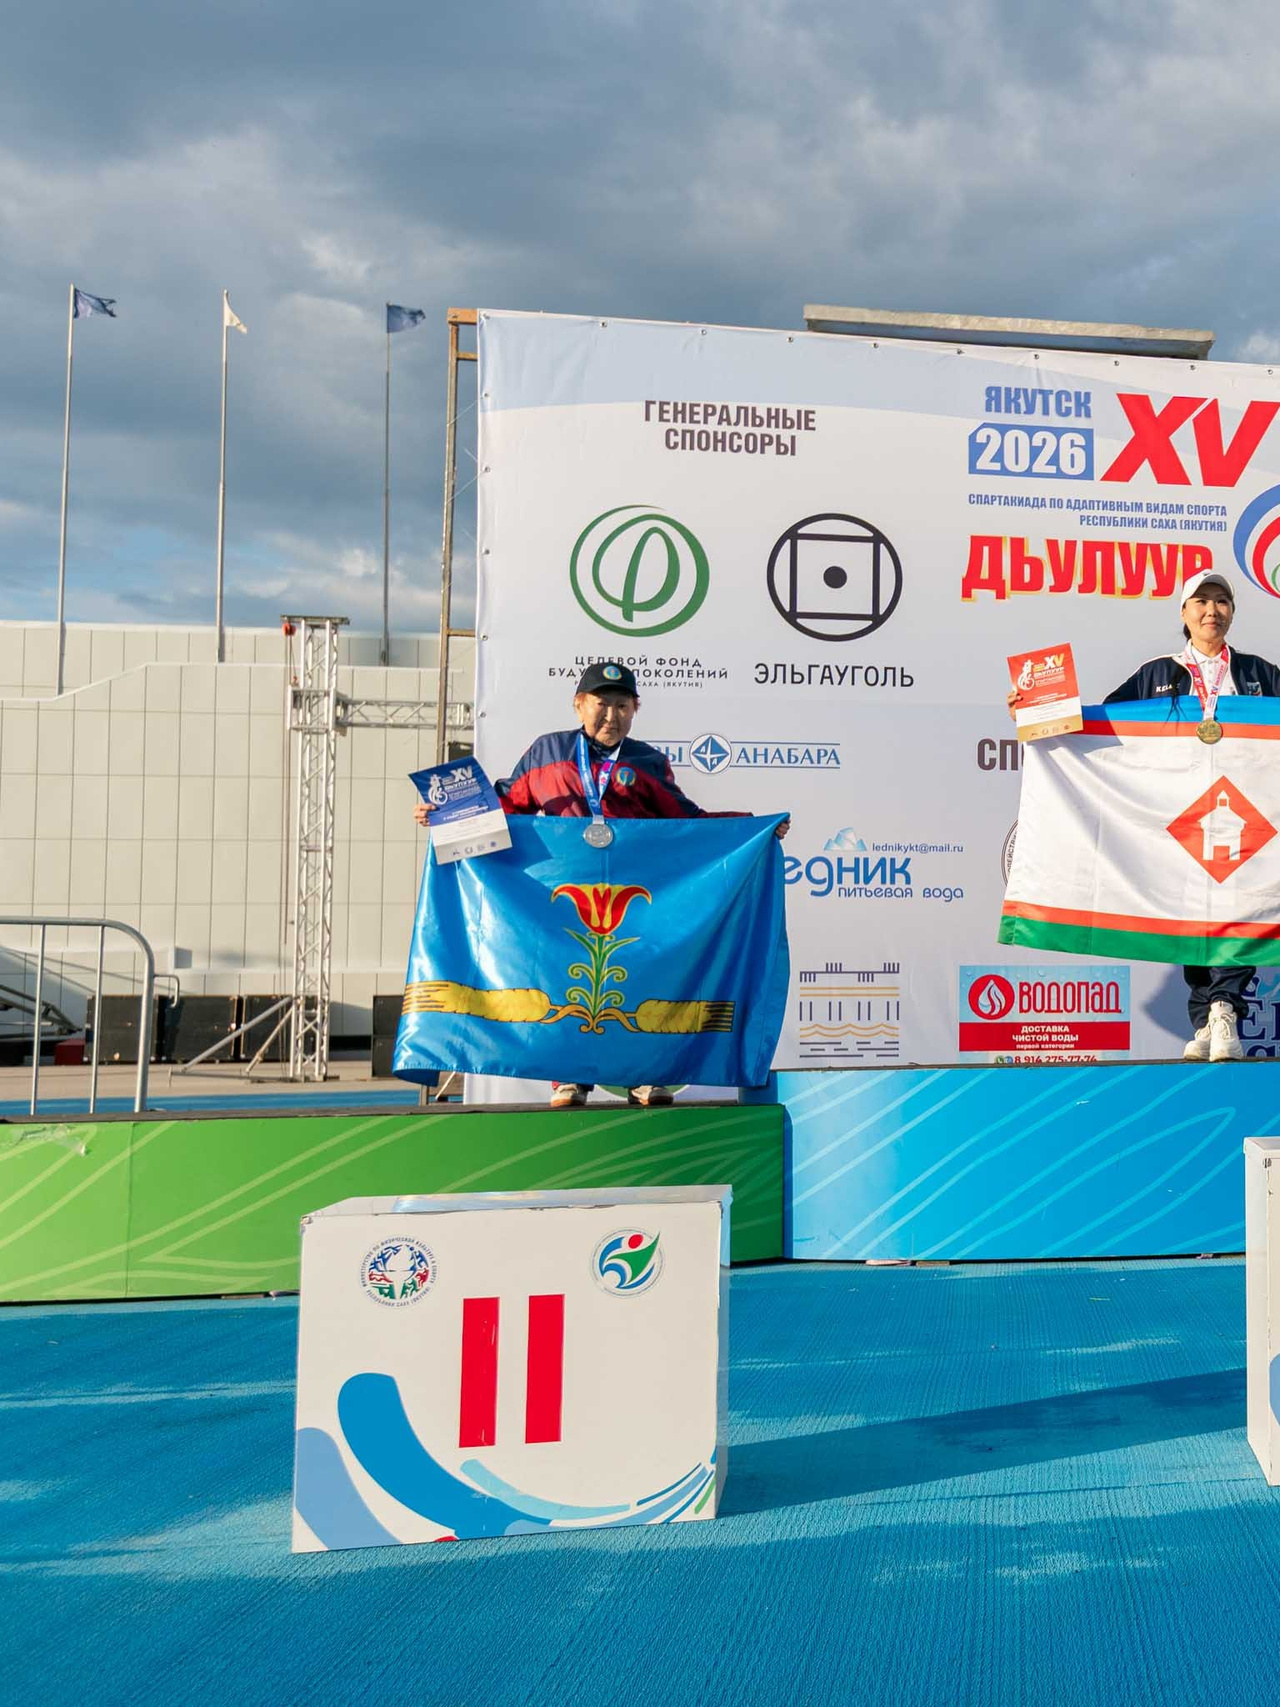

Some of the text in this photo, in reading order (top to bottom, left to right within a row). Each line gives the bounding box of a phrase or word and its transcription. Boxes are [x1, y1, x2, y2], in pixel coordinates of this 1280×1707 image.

[984, 386, 1092, 419] ЯКУТСК
[644, 400, 817, 431] ГЕНЕРАЛЬНЫЕ
[664, 428, 797, 456] СПОНСОРЫ
[975, 428, 1086, 475] 2026
[968, 493, 1227, 517] СПАРТАКИАДА ПО АДАПТИВНЫМ ВИДАМ СПОРТА
[1080, 515, 1227, 532] РЕСПУБЛИКИ САХА (ЯКУТИЯ)
[962, 535, 1213, 601] ДЬУЛУУР
[656, 657, 702, 668] ФОНД
[1044, 653, 1065, 669] XV
[634, 668, 728, 679] ПОКОЛЕНИЙ
[754, 663, 915, 688] ЭЛЬГАУГОЛЬ
[736, 747, 841, 765] АНАБАРА
[450, 766, 473, 782] XV
[872, 843, 964, 854] lednikykt@mail.ru
[784, 856, 912, 897] едник
[838, 887, 964, 903] питьевая вода
[1012, 1033, 1079, 1043] ЧИСТОЙ ВОДЫ
[1021, 1025, 1069, 1034] ДОСТАВКА
[1014, 1055, 1021, 1063] 8
[459, 1294, 566, 1448] II
